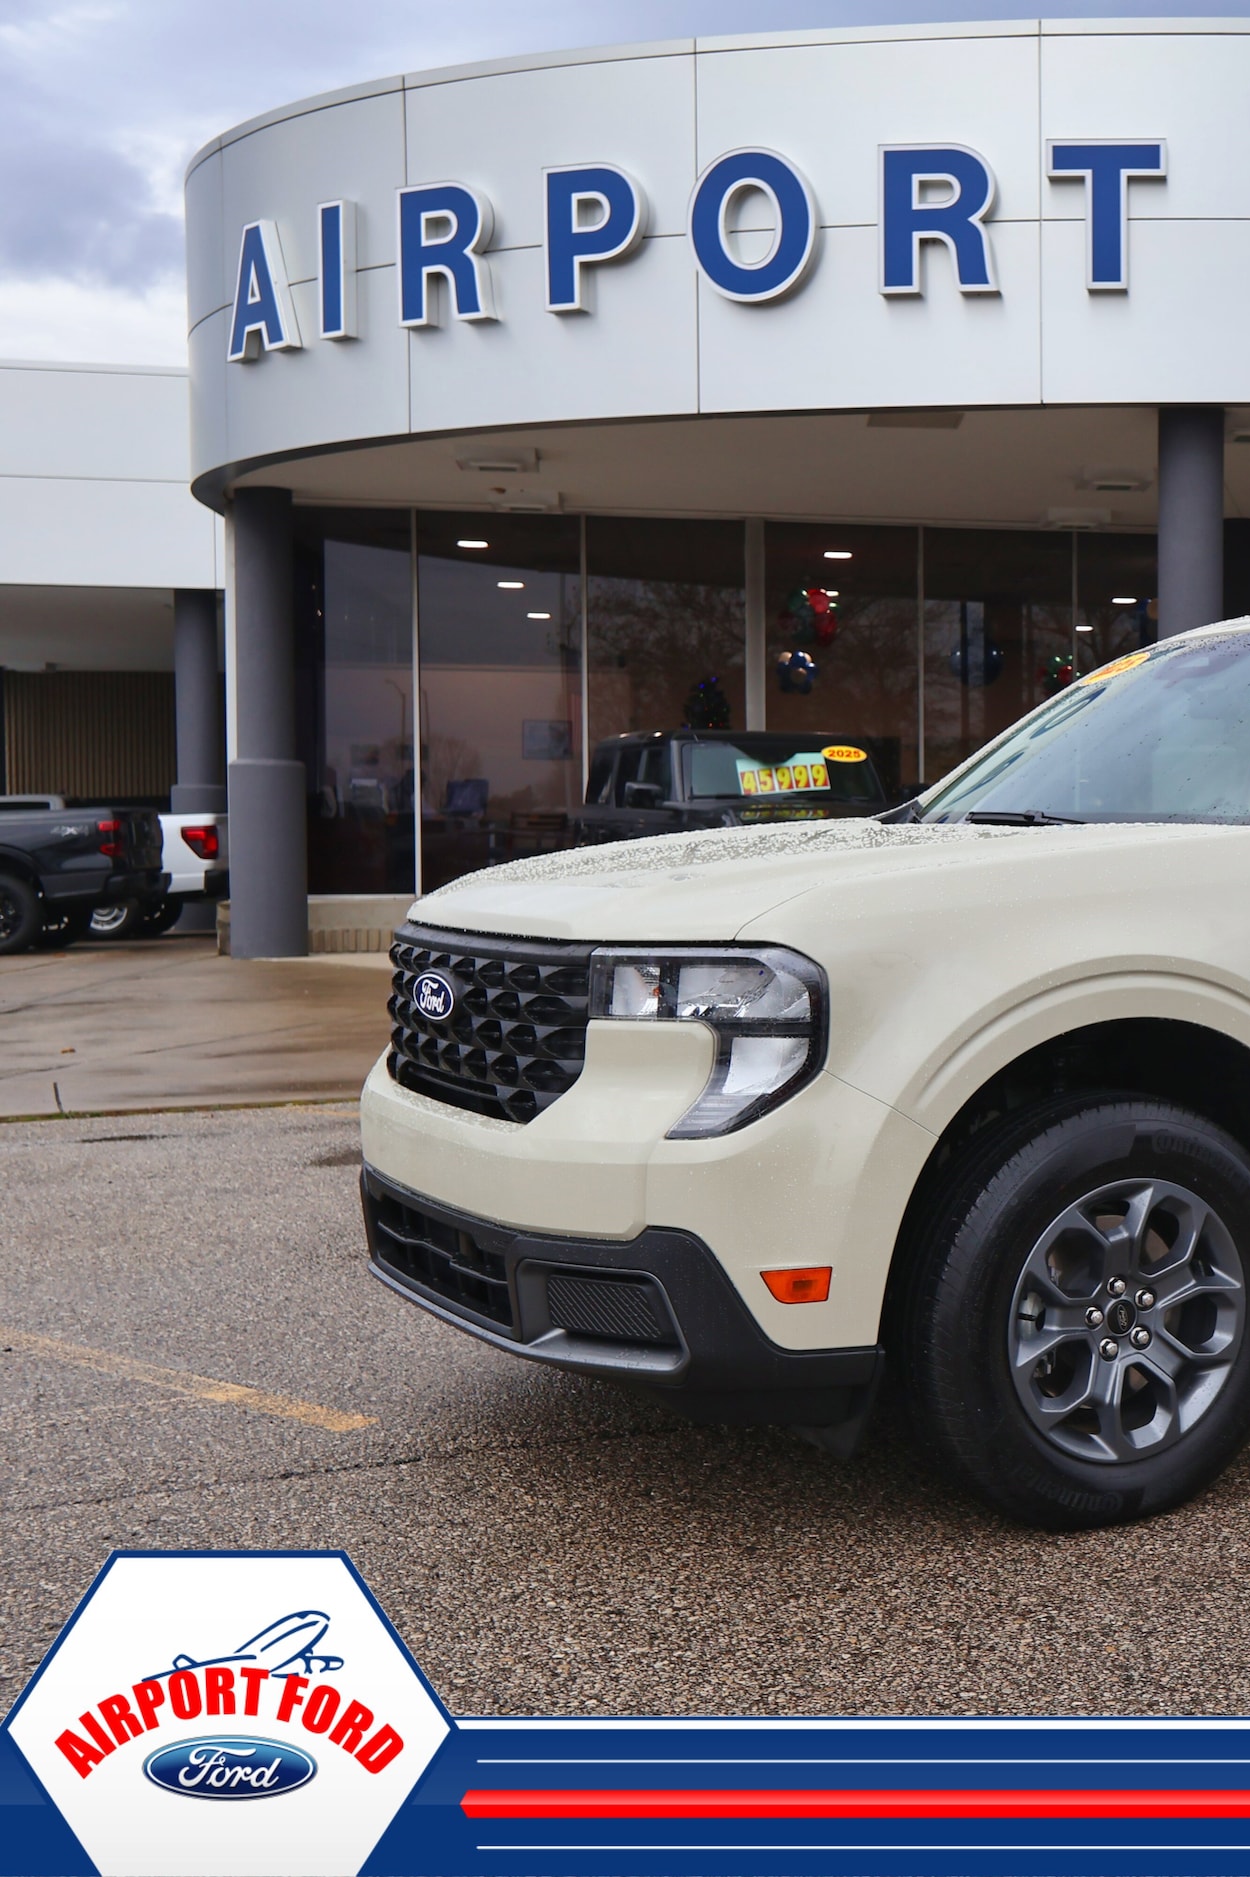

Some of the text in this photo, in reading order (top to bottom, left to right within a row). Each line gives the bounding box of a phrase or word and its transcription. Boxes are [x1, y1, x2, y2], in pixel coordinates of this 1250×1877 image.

[227, 137, 1168, 363] AIRPORT
[828, 749, 861, 759] 2025
[741, 764, 828, 794] 45999
[420, 979, 445, 1013] Ford
